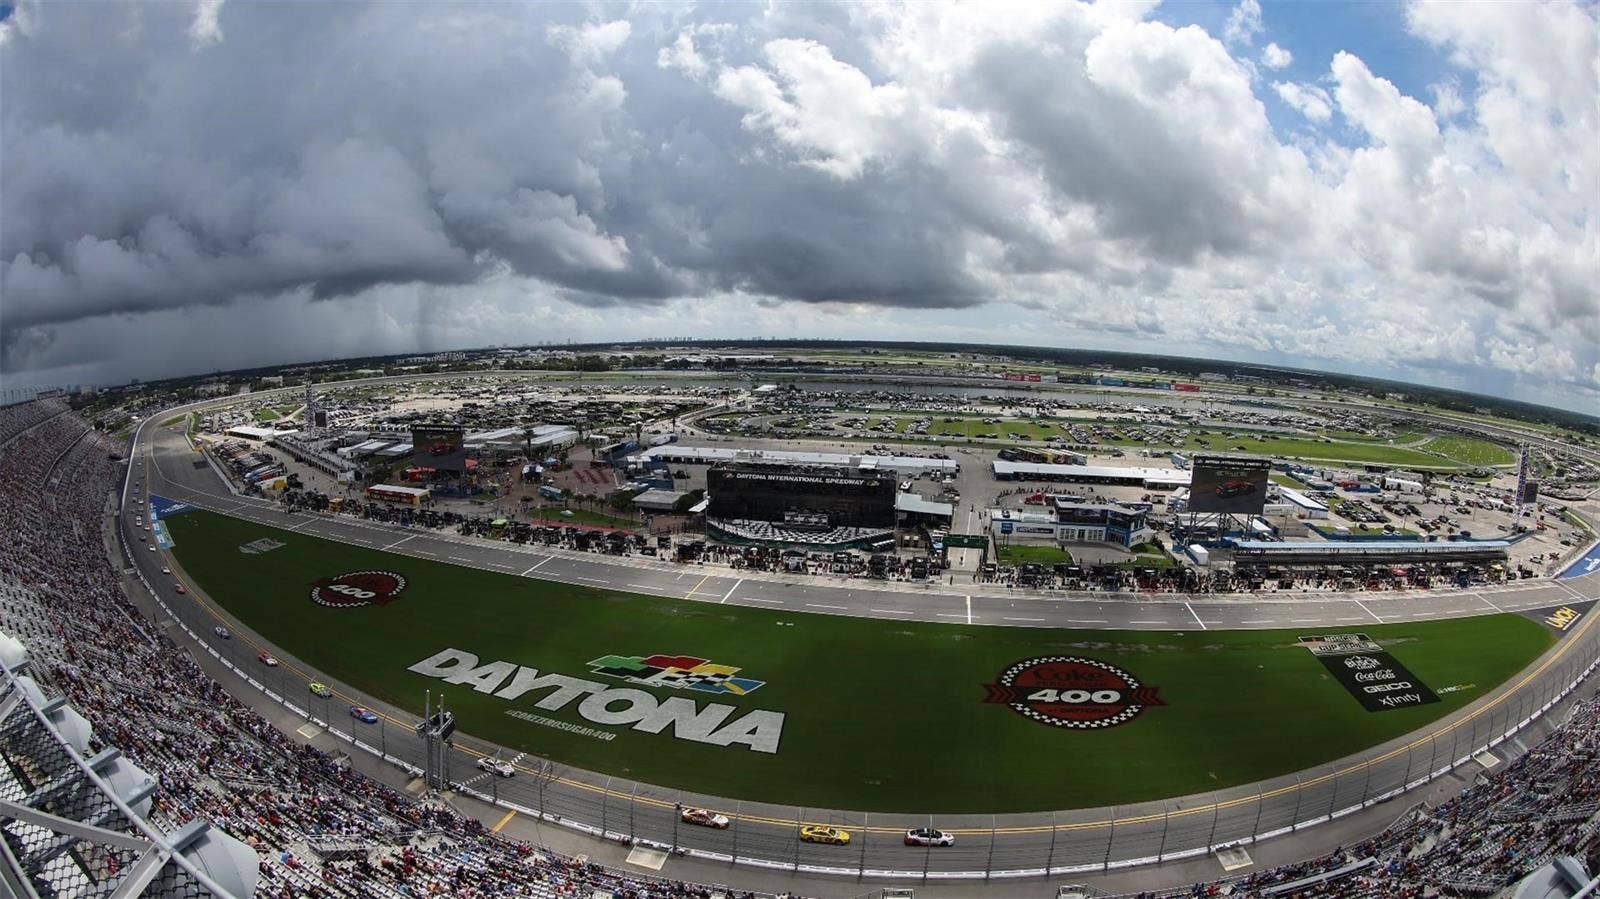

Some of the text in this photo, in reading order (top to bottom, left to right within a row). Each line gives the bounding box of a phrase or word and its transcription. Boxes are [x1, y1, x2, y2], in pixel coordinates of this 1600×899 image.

[768, 475, 823, 483] INTERNATIONAL
[825, 478, 865, 486] SPEEDWAY
[328, 584, 376, 599] 400
[1033, 668, 1103, 681] Coke
[1355, 669, 1396, 683] Coca-Cola
[1363, 681, 1413, 694] GEICO
[406, 648, 786, 754] DAYTONA
[1026, 689, 1121, 704] 400
[1379, 693, 1422, 707] xfinity
